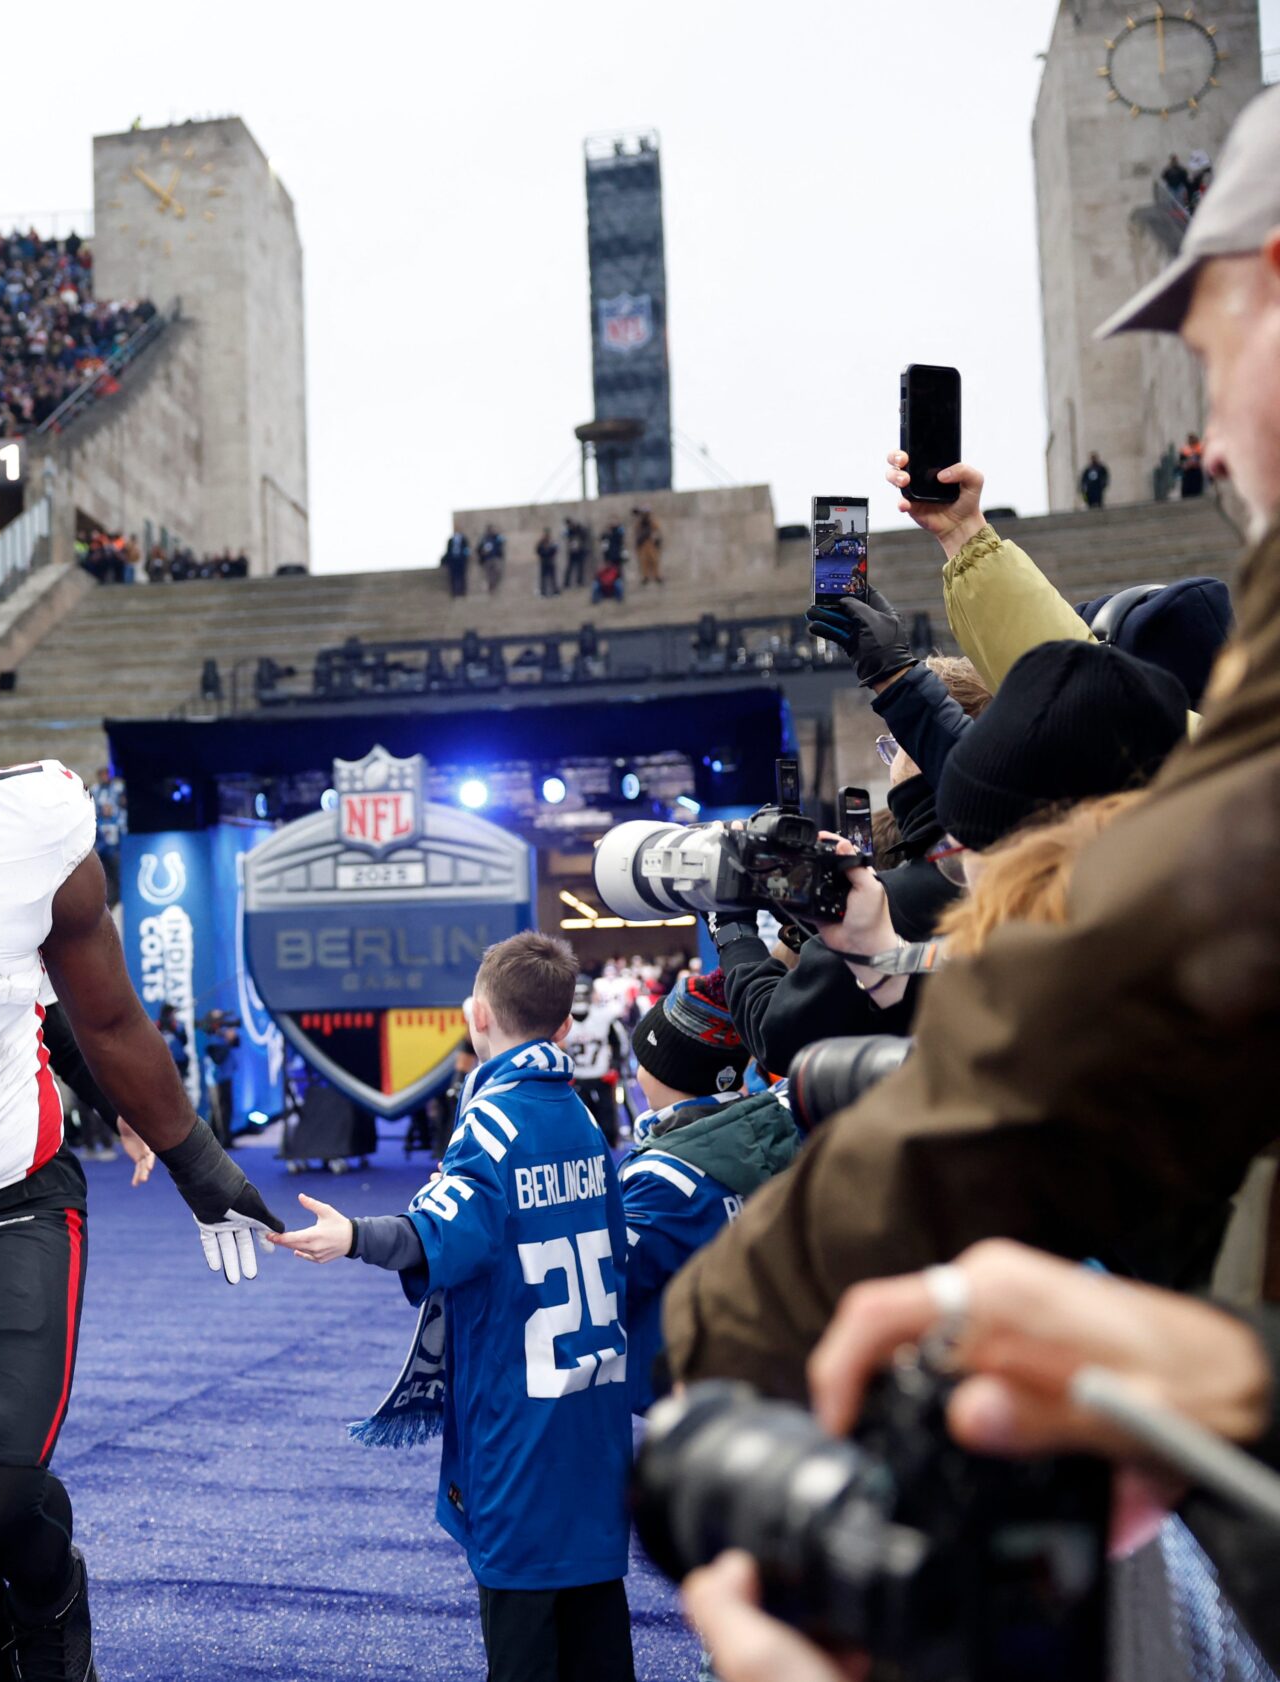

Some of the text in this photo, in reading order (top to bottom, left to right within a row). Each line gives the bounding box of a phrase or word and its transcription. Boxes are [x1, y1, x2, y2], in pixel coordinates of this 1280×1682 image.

[345, 794, 413, 844] NFL
[353, 867, 408, 883] 2025
[140, 916, 164, 1003] COLTS
[276, 923, 489, 970] BERLIN
[571, 1039, 602, 1067] 27
[517, 1228, 628, 1399] 25
